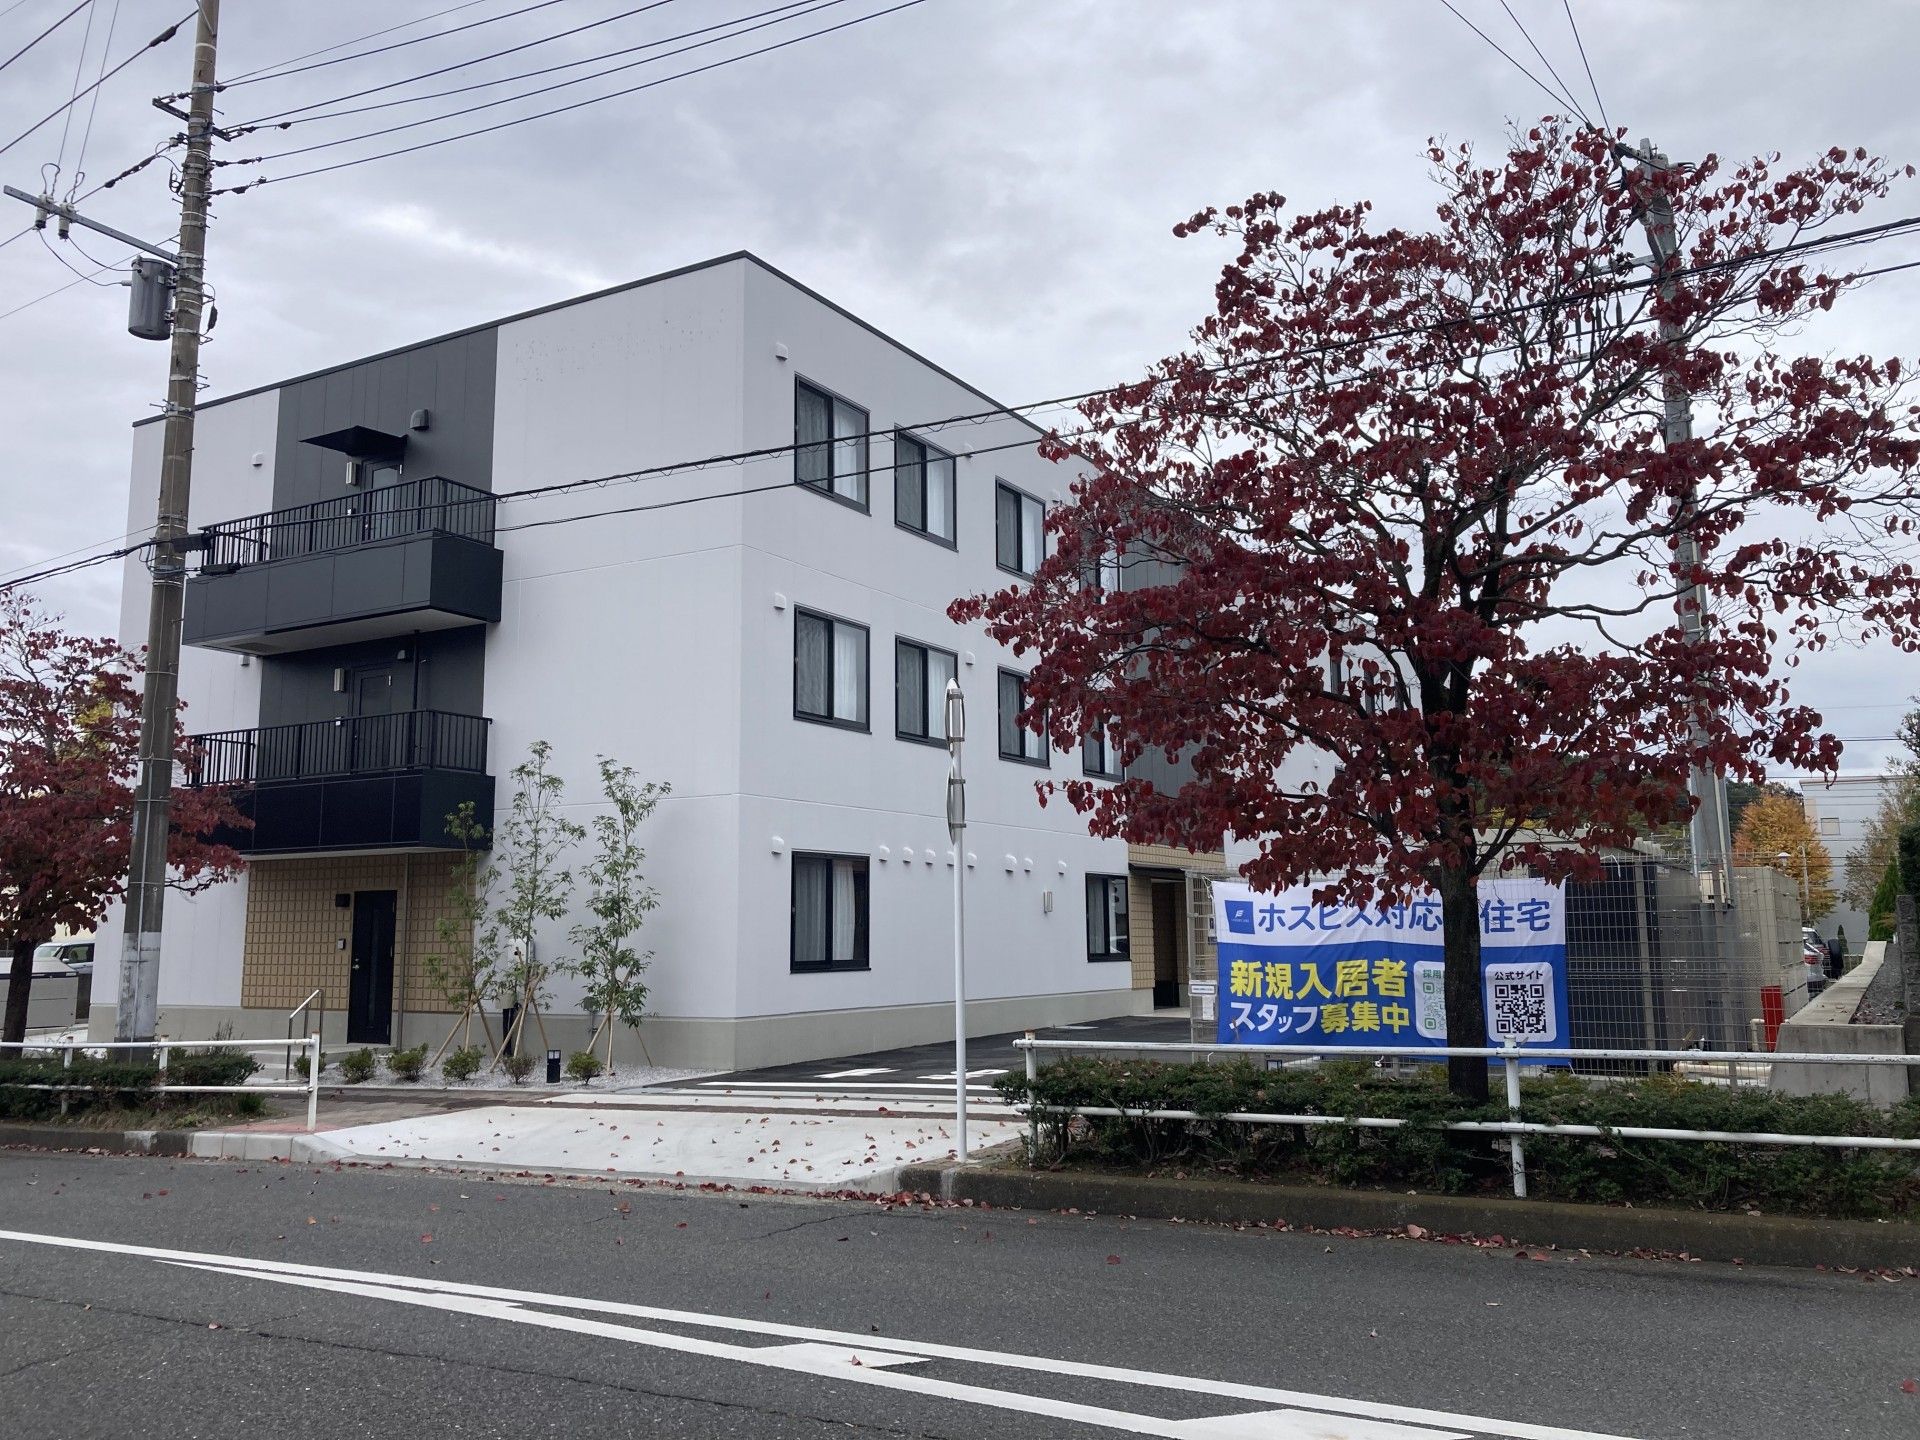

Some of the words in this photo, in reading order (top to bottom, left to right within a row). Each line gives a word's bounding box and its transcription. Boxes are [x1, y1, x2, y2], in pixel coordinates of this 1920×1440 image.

[1258, 897, 1550, 934] ホスピス対応住宅
[1230, 958, 1408, 1000] 新規入居者
[1494, 970, 1543, 981] 公式サイト
[1229, 1001, 1410, 1034] スタッフ募集中
